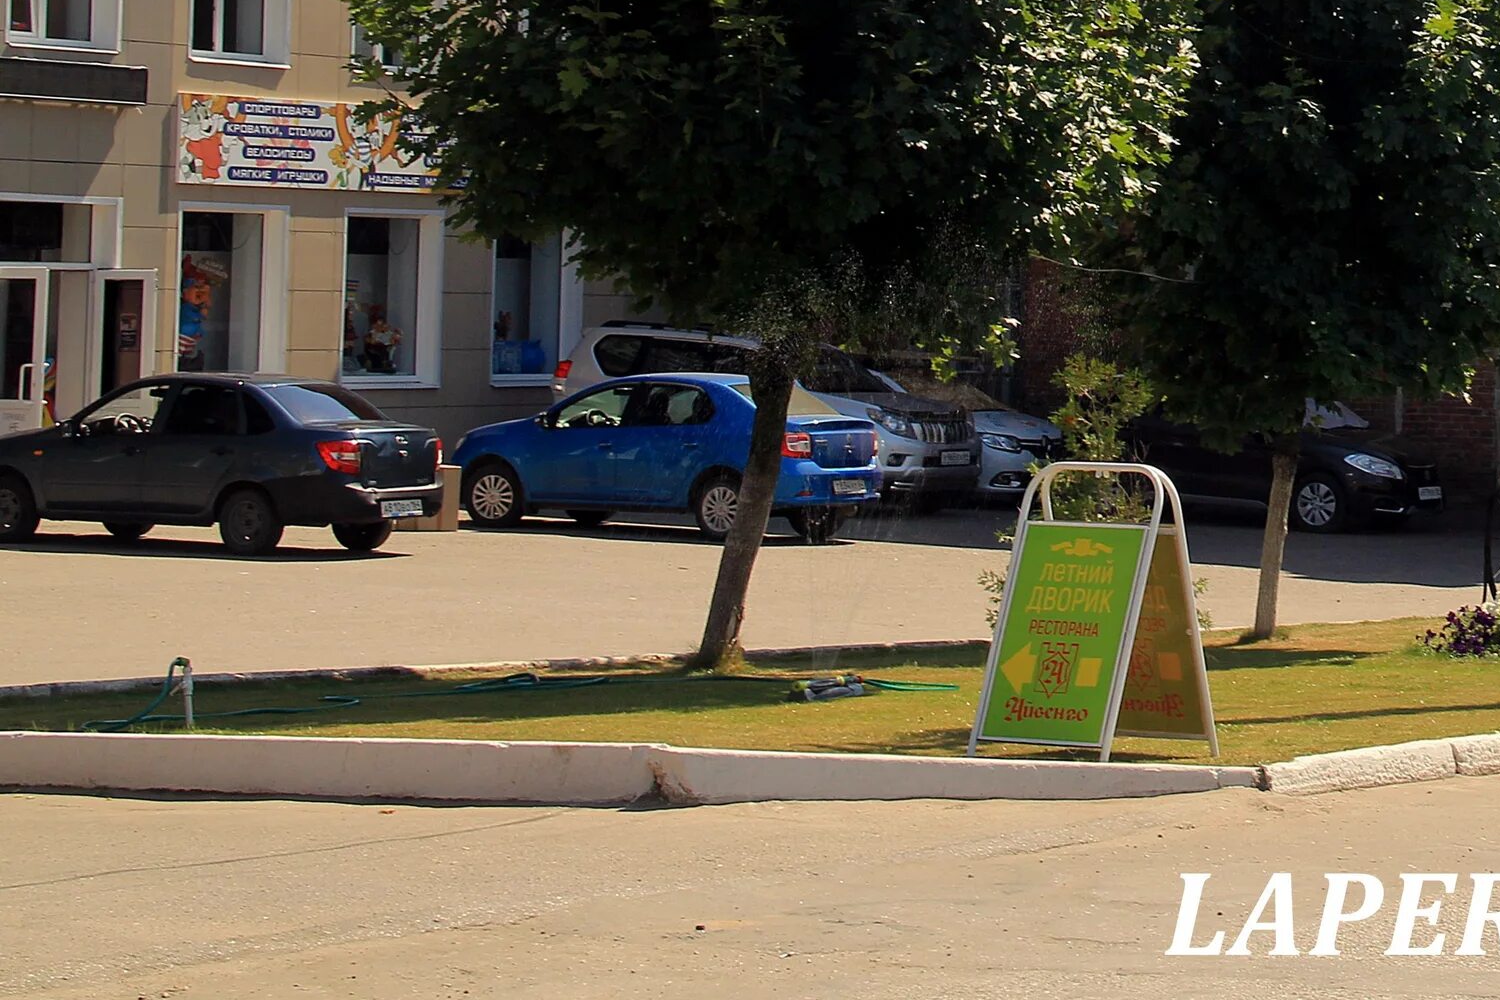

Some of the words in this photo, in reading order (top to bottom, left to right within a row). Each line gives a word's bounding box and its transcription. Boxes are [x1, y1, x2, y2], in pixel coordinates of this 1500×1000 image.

[244, 104, 317, 117] СПОРТТОВАРЫ
[226, 123, 283, 136] КРОВАТКИ,
[288, 127, 333, 138] СТОЛИКИ
[246, 147, 312, 160] ВЕЛОСИПЕДЫ
[231, 169, 271, 180] МЯГКИЕ
[277, 170, 325, 182] ИГРУШКИ
[368, 175, 420, 186] НАДУВНЫЕ
[1025, 586, 1114, 614] ДВОРИК
[1028, 619, 1100, 637] РЕСТОРАНА
[1003, 696, 1088, 723] Айвенго
